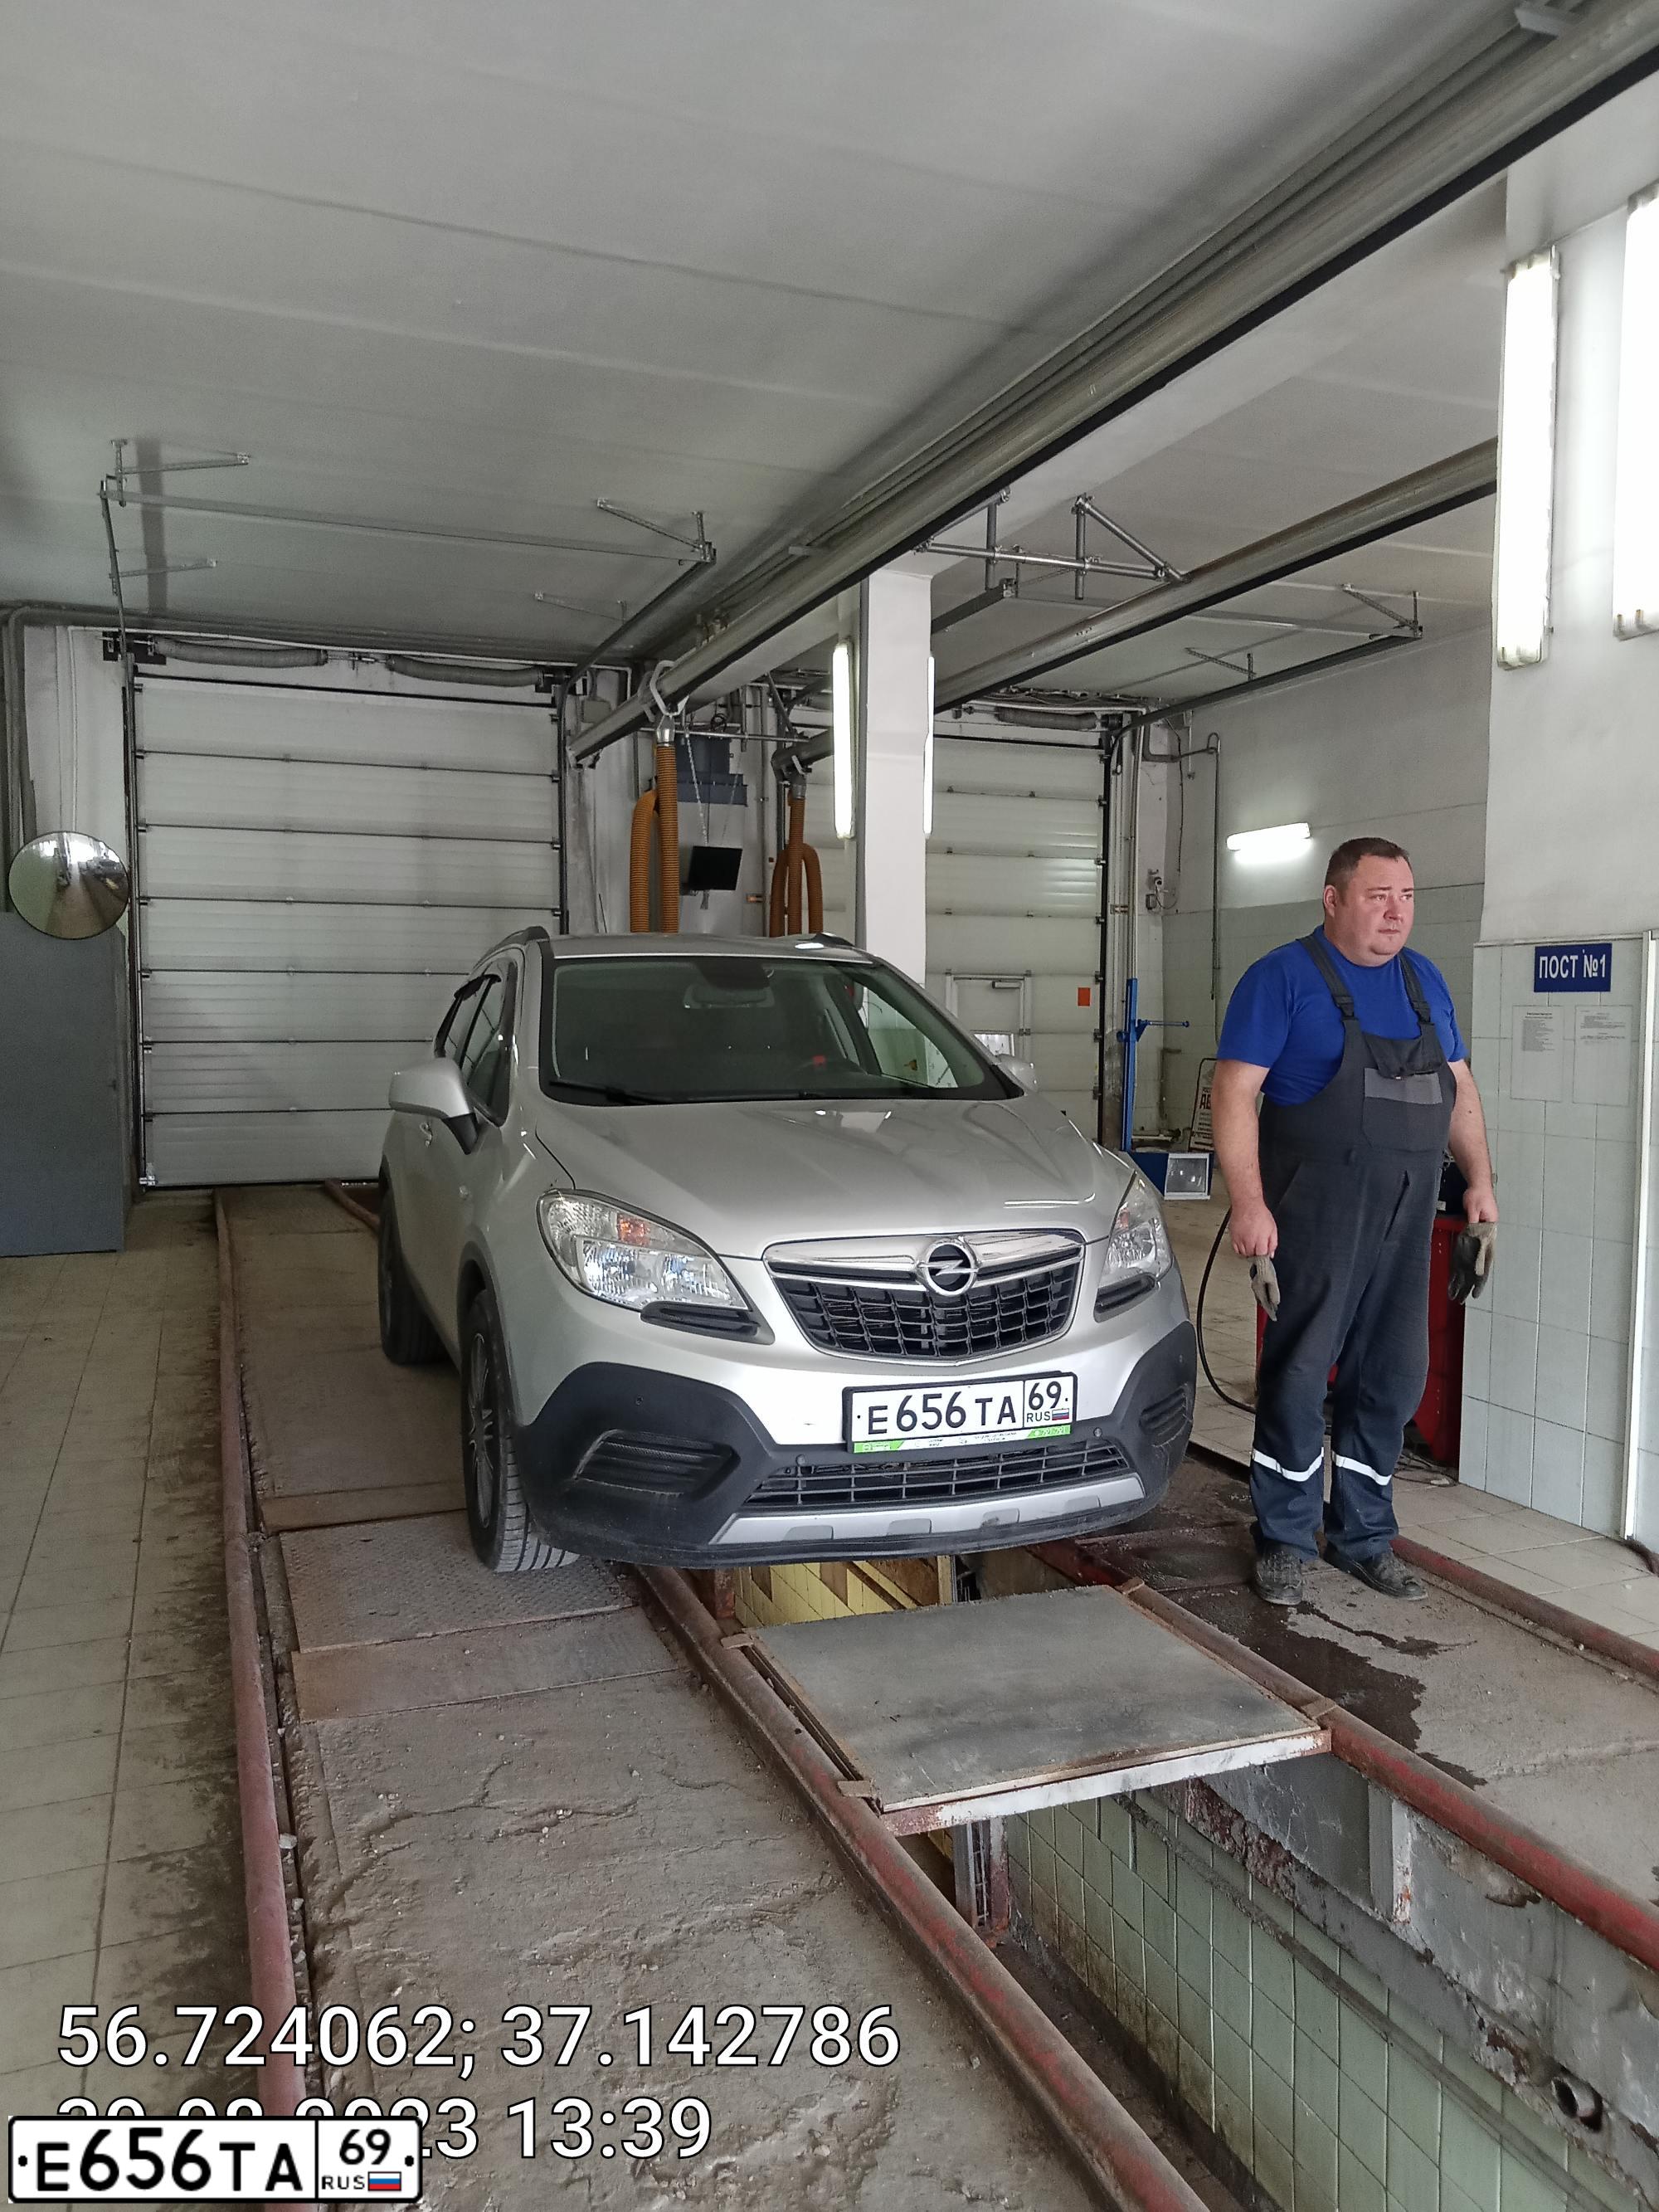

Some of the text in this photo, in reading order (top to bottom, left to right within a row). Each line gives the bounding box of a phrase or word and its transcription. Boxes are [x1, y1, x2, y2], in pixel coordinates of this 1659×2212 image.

[1539, 954, 1606, 979] ПОСТ №1
[1028, 1381, 1062, 1411] 69
[1026, 1410, 1051, 1423] RUS
